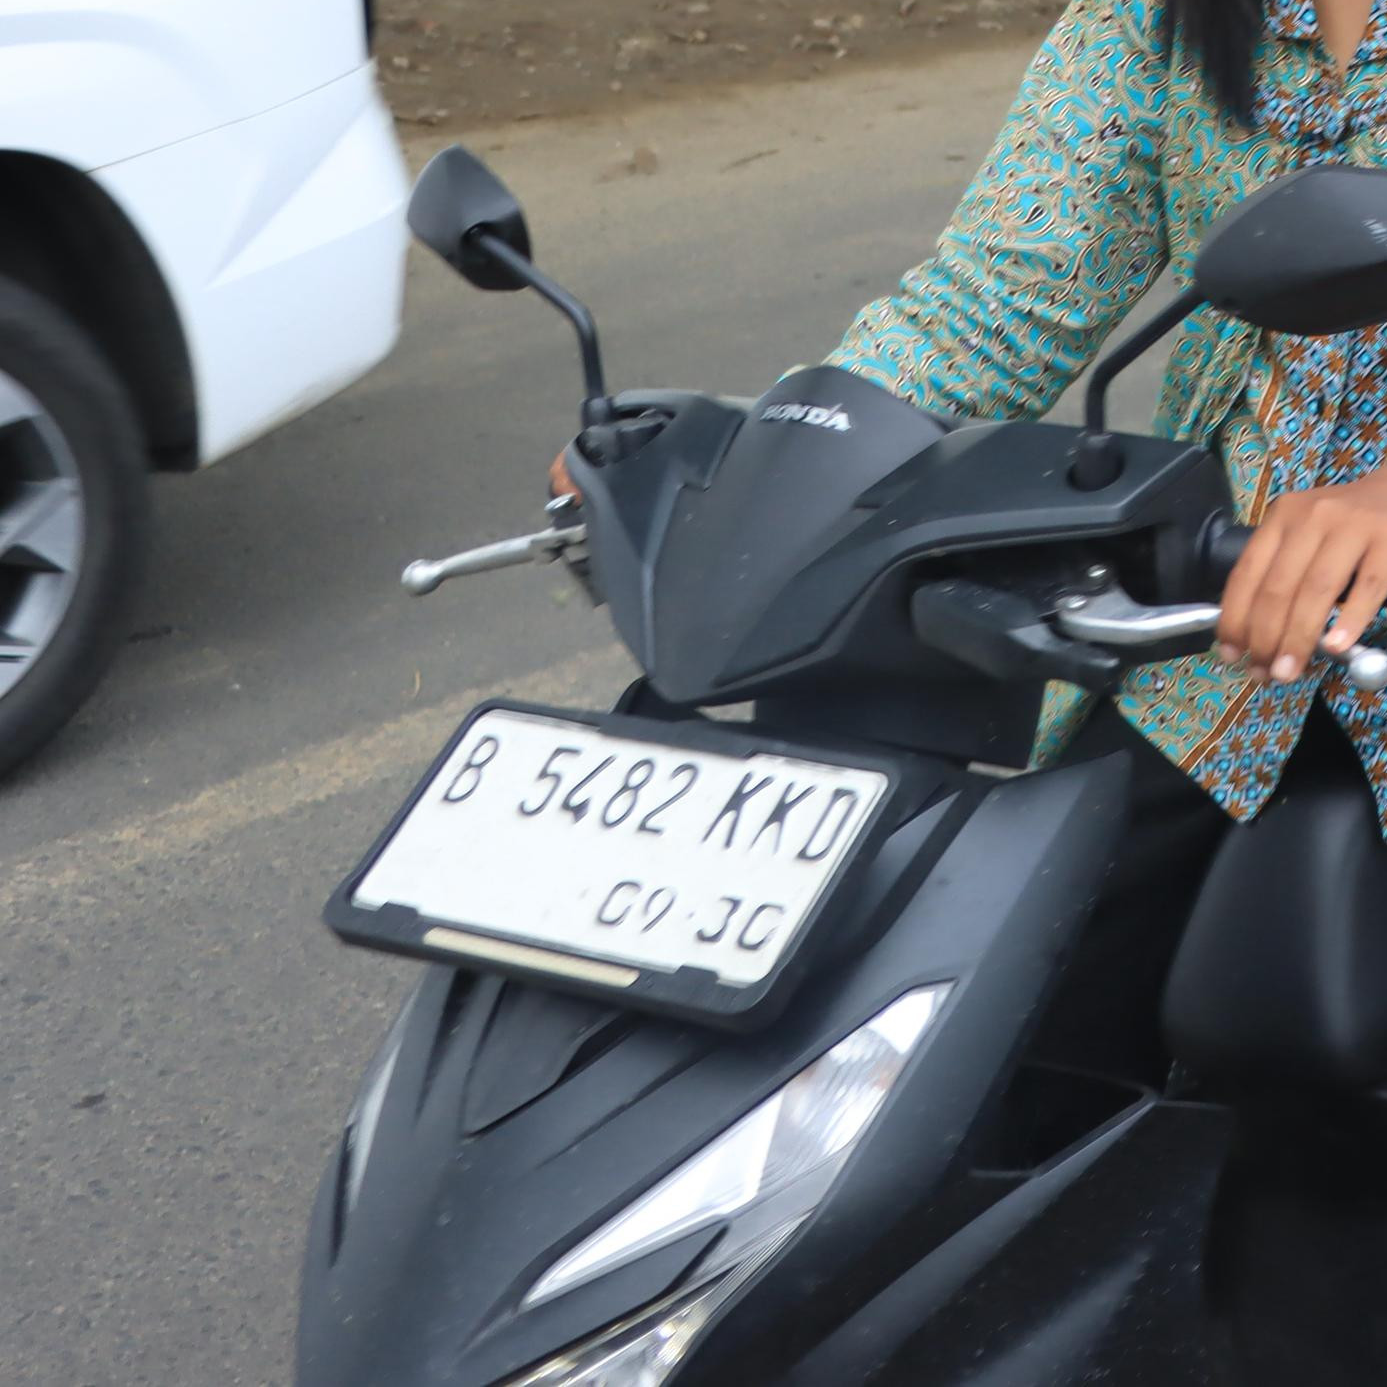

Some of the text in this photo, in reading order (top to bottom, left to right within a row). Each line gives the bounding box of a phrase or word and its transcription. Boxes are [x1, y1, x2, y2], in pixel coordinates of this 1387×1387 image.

[760, 402, 852, 432] HONDA
[443, 735, 861, 862] B 5482 KKD
